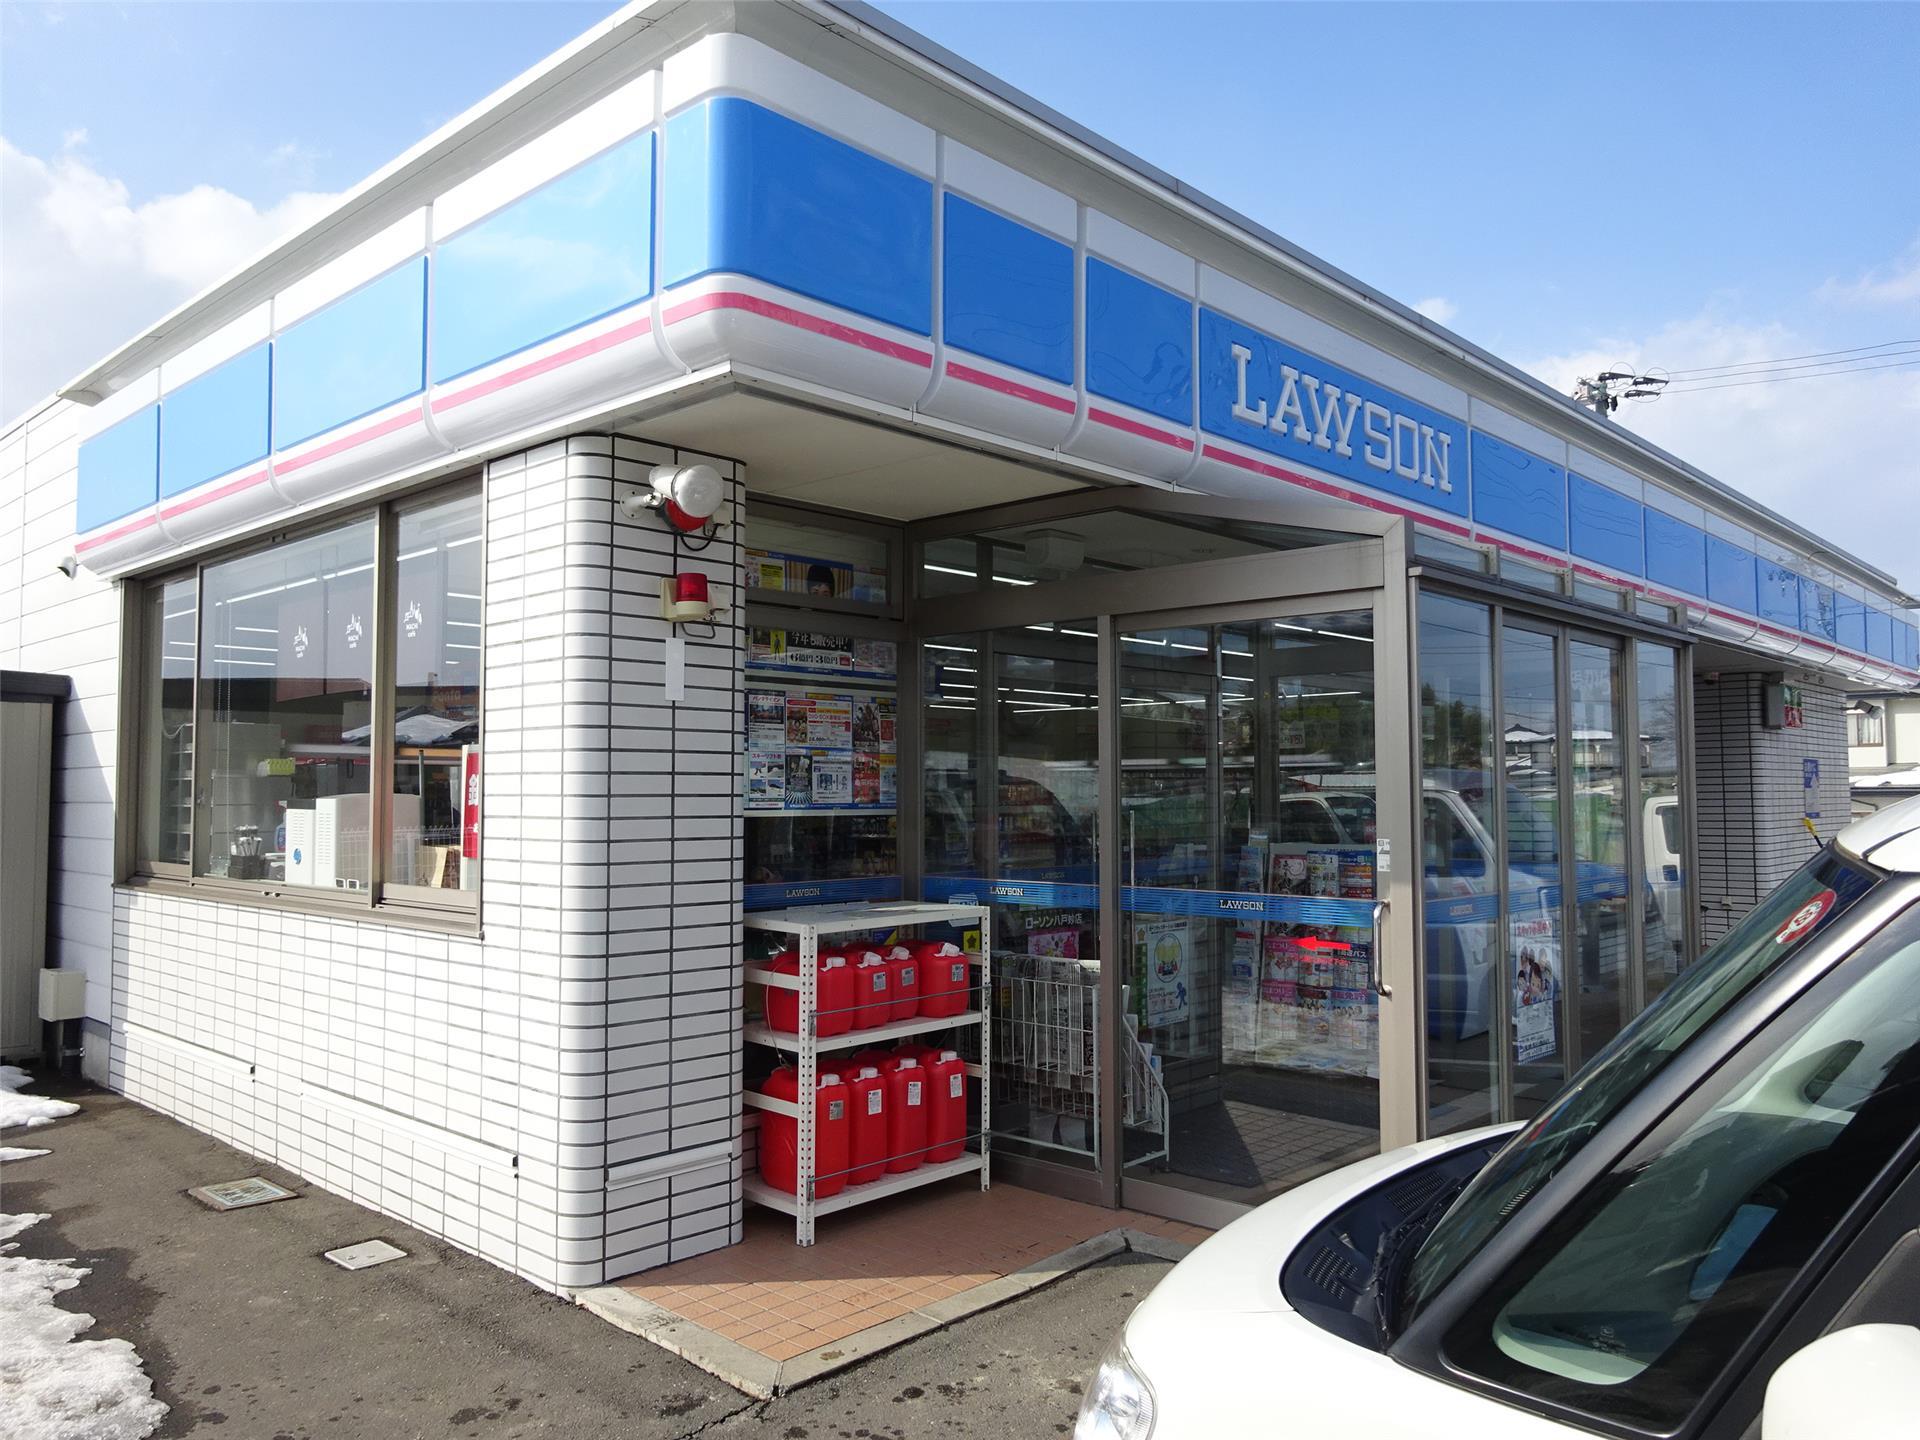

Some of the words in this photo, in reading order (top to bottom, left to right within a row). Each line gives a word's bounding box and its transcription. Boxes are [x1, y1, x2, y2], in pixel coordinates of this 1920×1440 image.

[1231, 343, 1453, 494] LAWSON
[786, 887, 821, 898] LAWSON
[990, 886, 1024, 896] LAWSON
[1220, 899, 1264, 911] LAWSON
